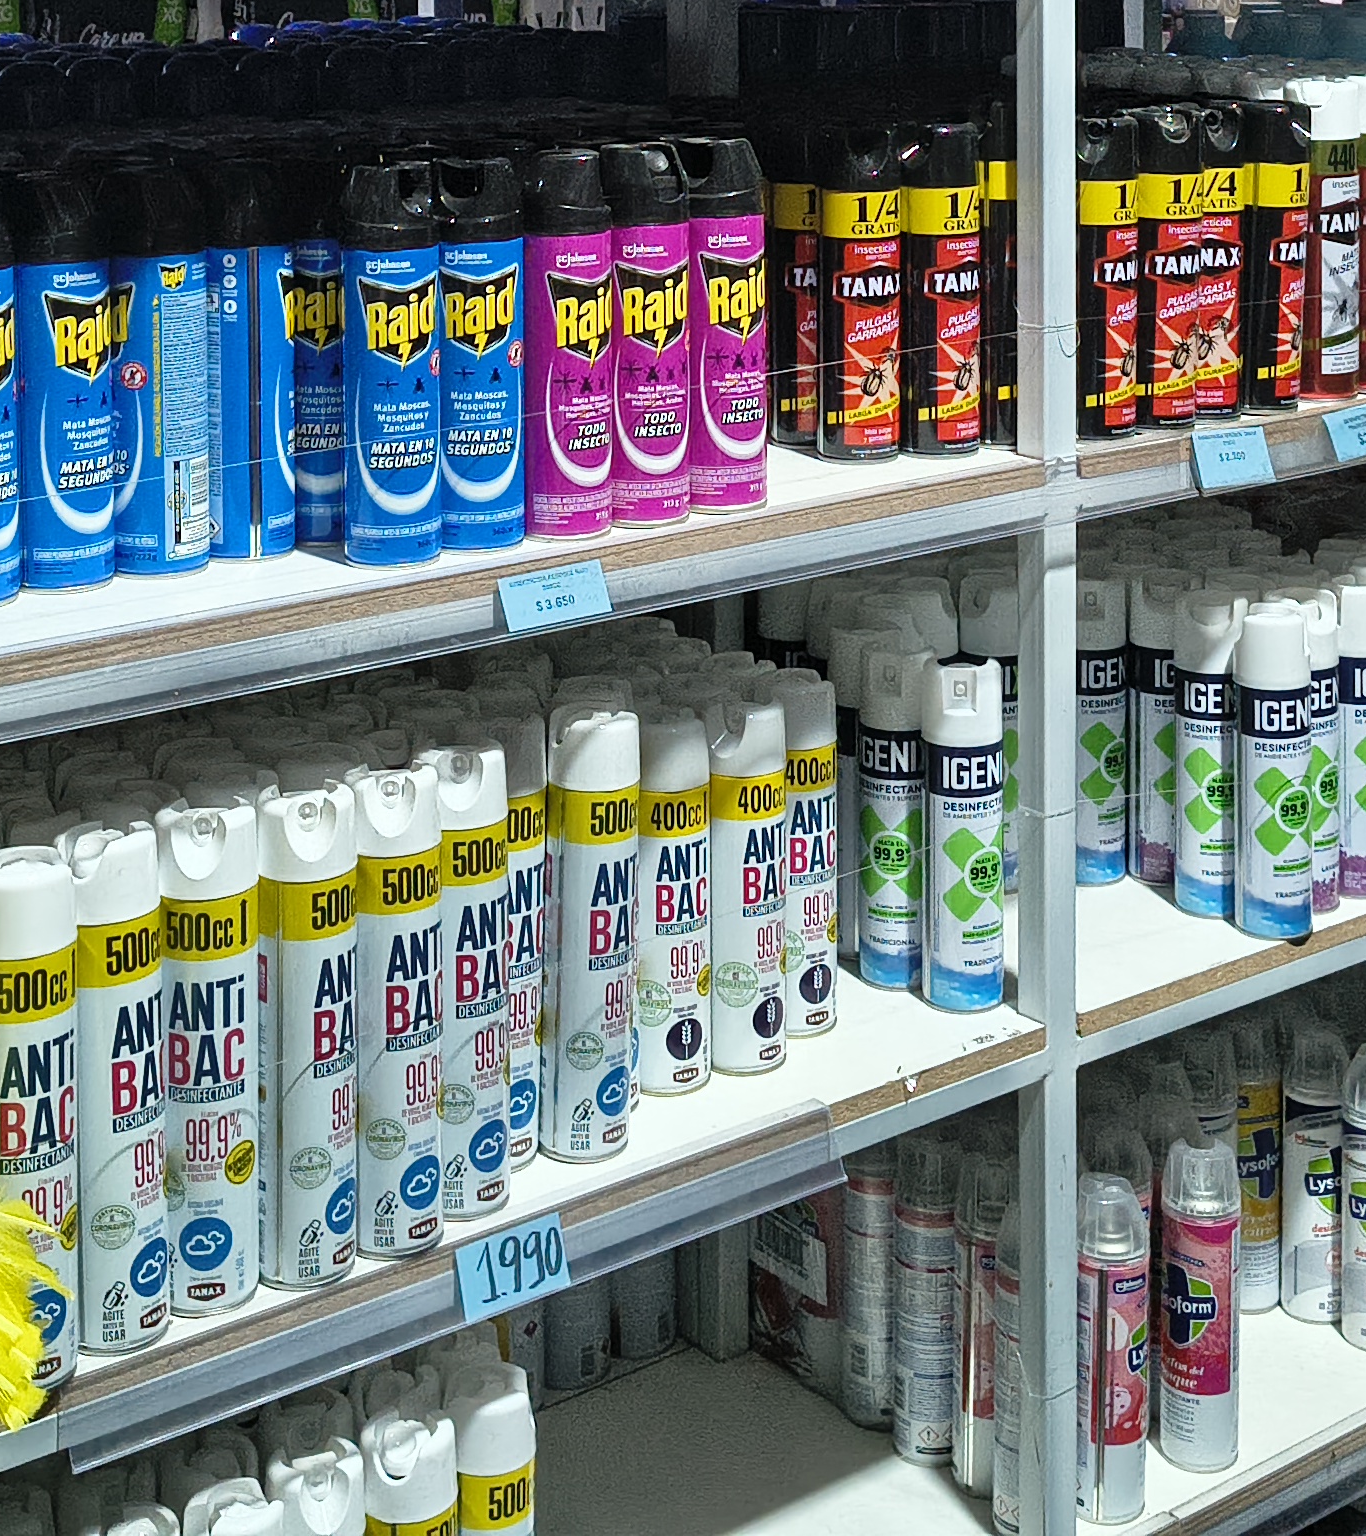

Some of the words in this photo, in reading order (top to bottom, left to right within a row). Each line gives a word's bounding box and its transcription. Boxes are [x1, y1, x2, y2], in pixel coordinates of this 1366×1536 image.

[852, 192, 900, 224] 1/4
[851, 220, 900, 235] GRATIS
[367, 288, 436, 350] Raid
[445, 280, 515, 341] Raid
[621, 280, 687, 340] Raid
[634, 422, 682, 438] INSECTO
[643, 412, 676, 426] TODO
[448, 431, 478, 443] MATA
[481, 429, 499, 442] EN
[501, 428, 513, 440] 10
[545, 594, 576, 610] 3.650
[651, 800, 702, 832] 400cc
[165, 911, 234, 953] 500cc
[168, 1027, 245, 1087] BAC
[169, 1080, 244, 1103] DESINFECTANTE
[373, 1216, 395, 1230] AGITE
[373, 1235, 395, 1249] USAR
